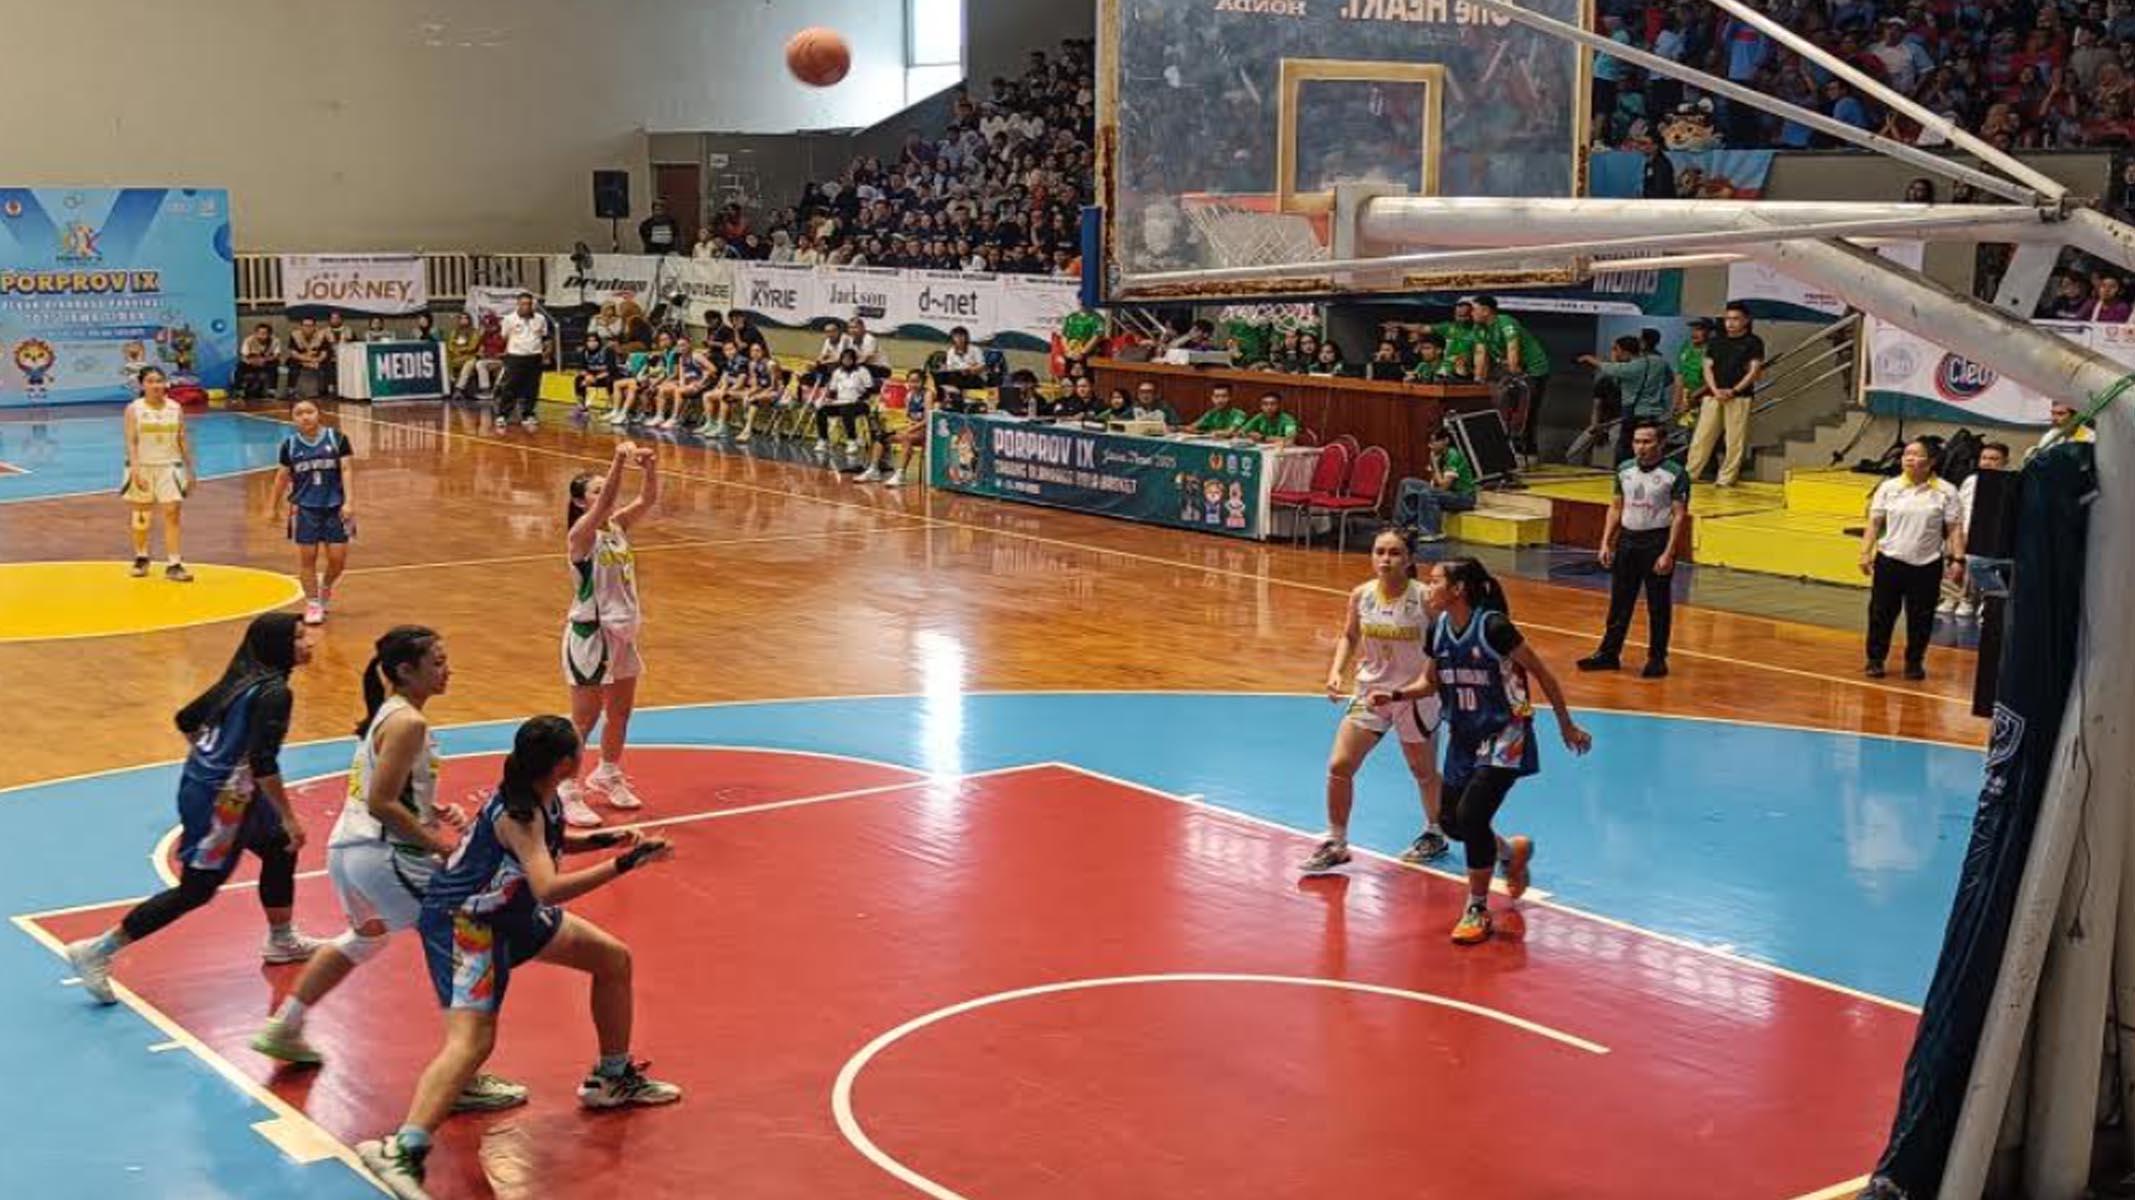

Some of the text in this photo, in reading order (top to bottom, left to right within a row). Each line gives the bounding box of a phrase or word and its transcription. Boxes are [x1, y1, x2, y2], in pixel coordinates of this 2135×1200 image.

[0, 270, 160, 294] PORPROV IX
[750, 288, 798, 309] KYRIE
[376, 351, 434, 380] MEDIS
[993, 428, 1096, 469] PORPROV IX
[1457, 687, 1477, 711] 10
